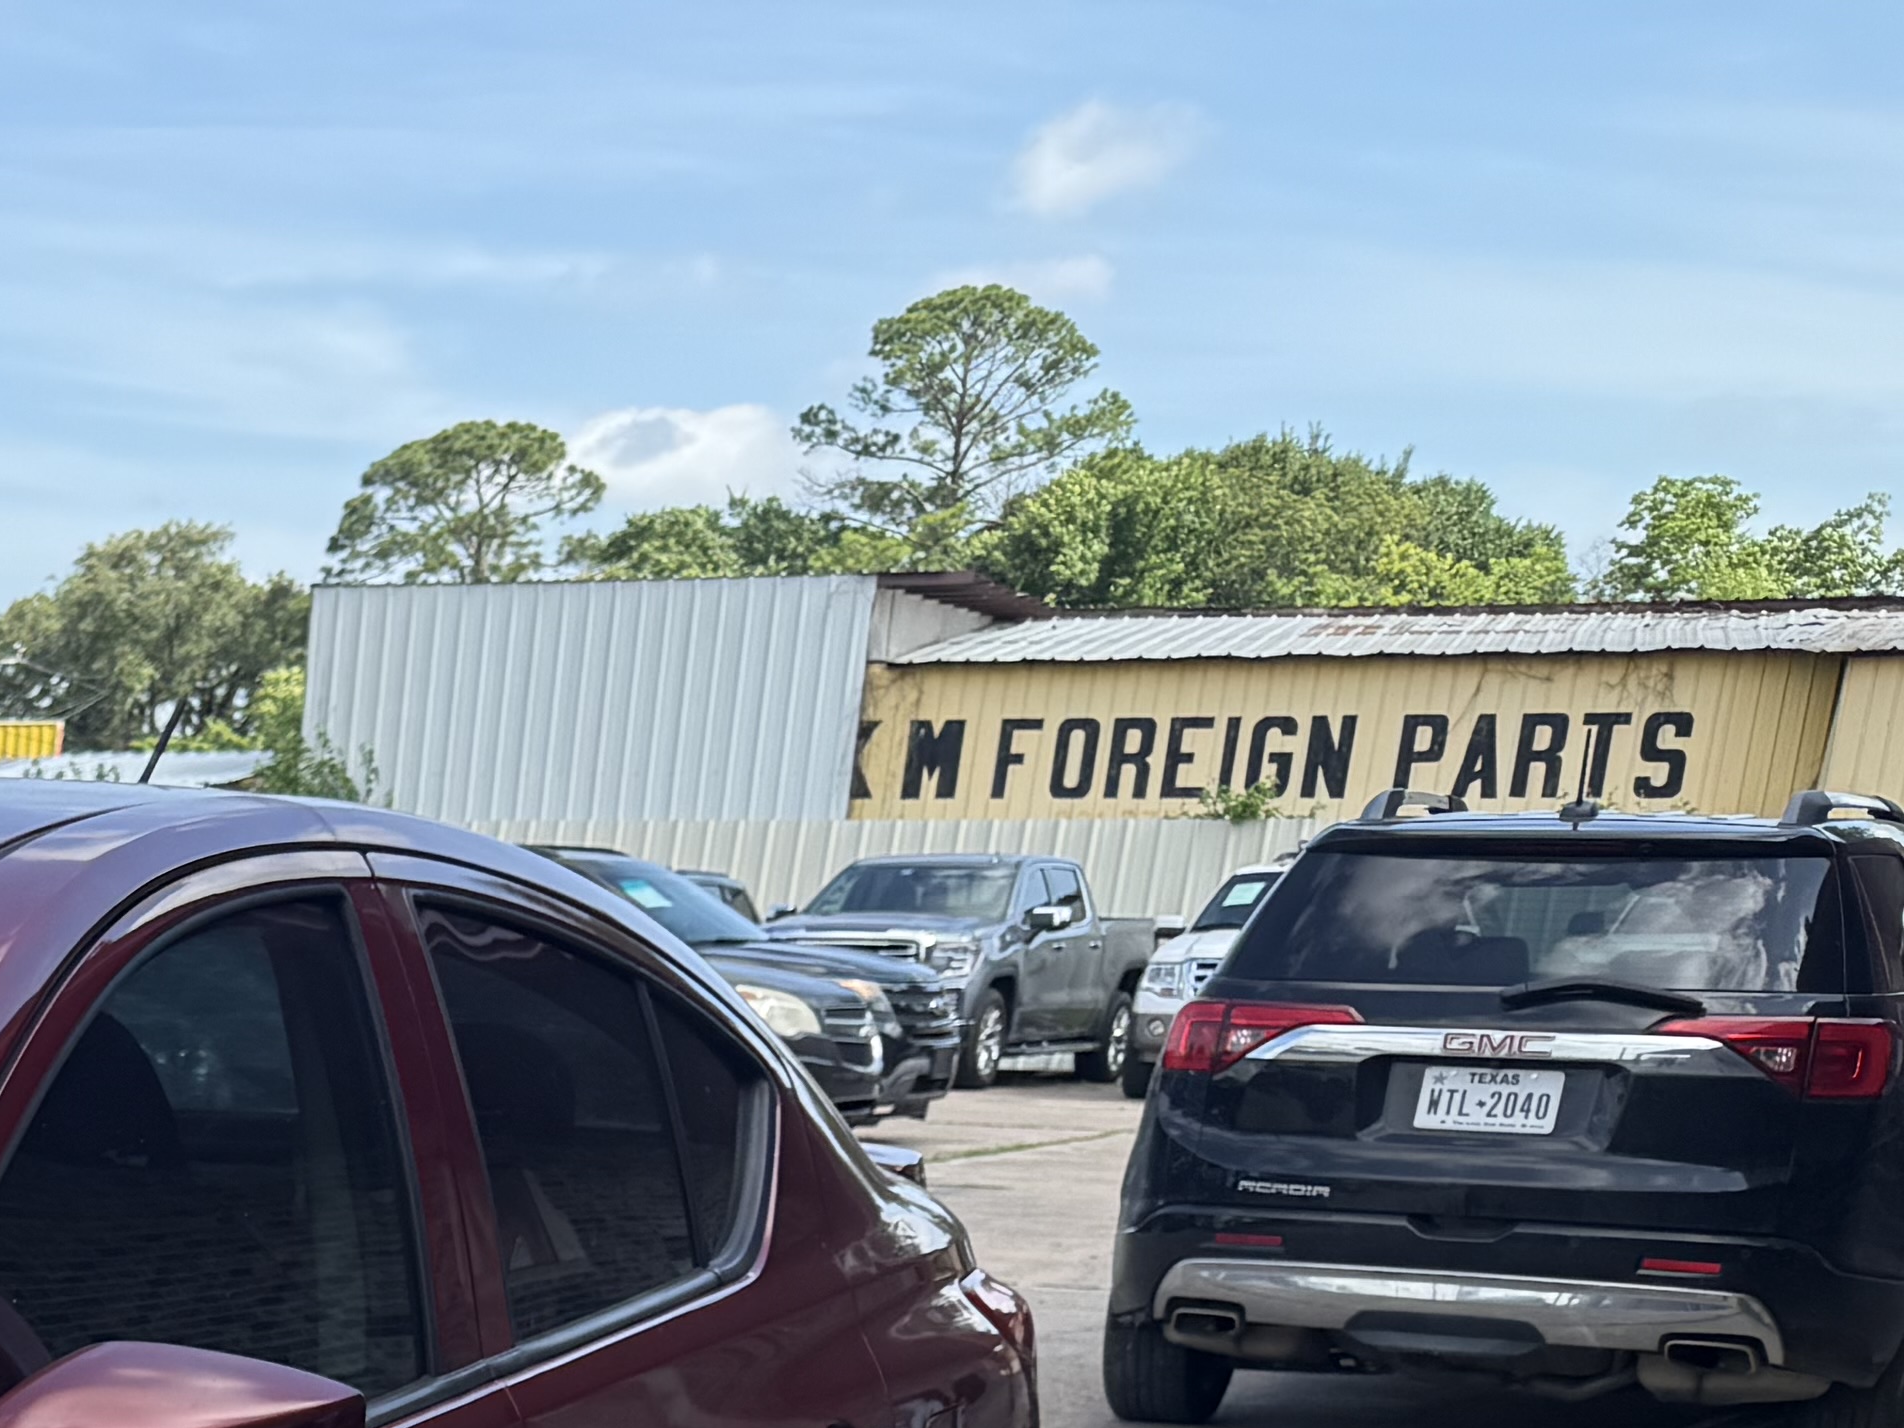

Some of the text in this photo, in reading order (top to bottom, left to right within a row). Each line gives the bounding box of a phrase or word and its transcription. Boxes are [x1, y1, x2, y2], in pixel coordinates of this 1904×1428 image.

[991, 714, 1359, 800] FOREIGN
[1393, 712, 1694, 799] PARTS
[1443, 1032, 1556, 1060] GMC
[1469, 1072, 1521, 1086] TEXAS
